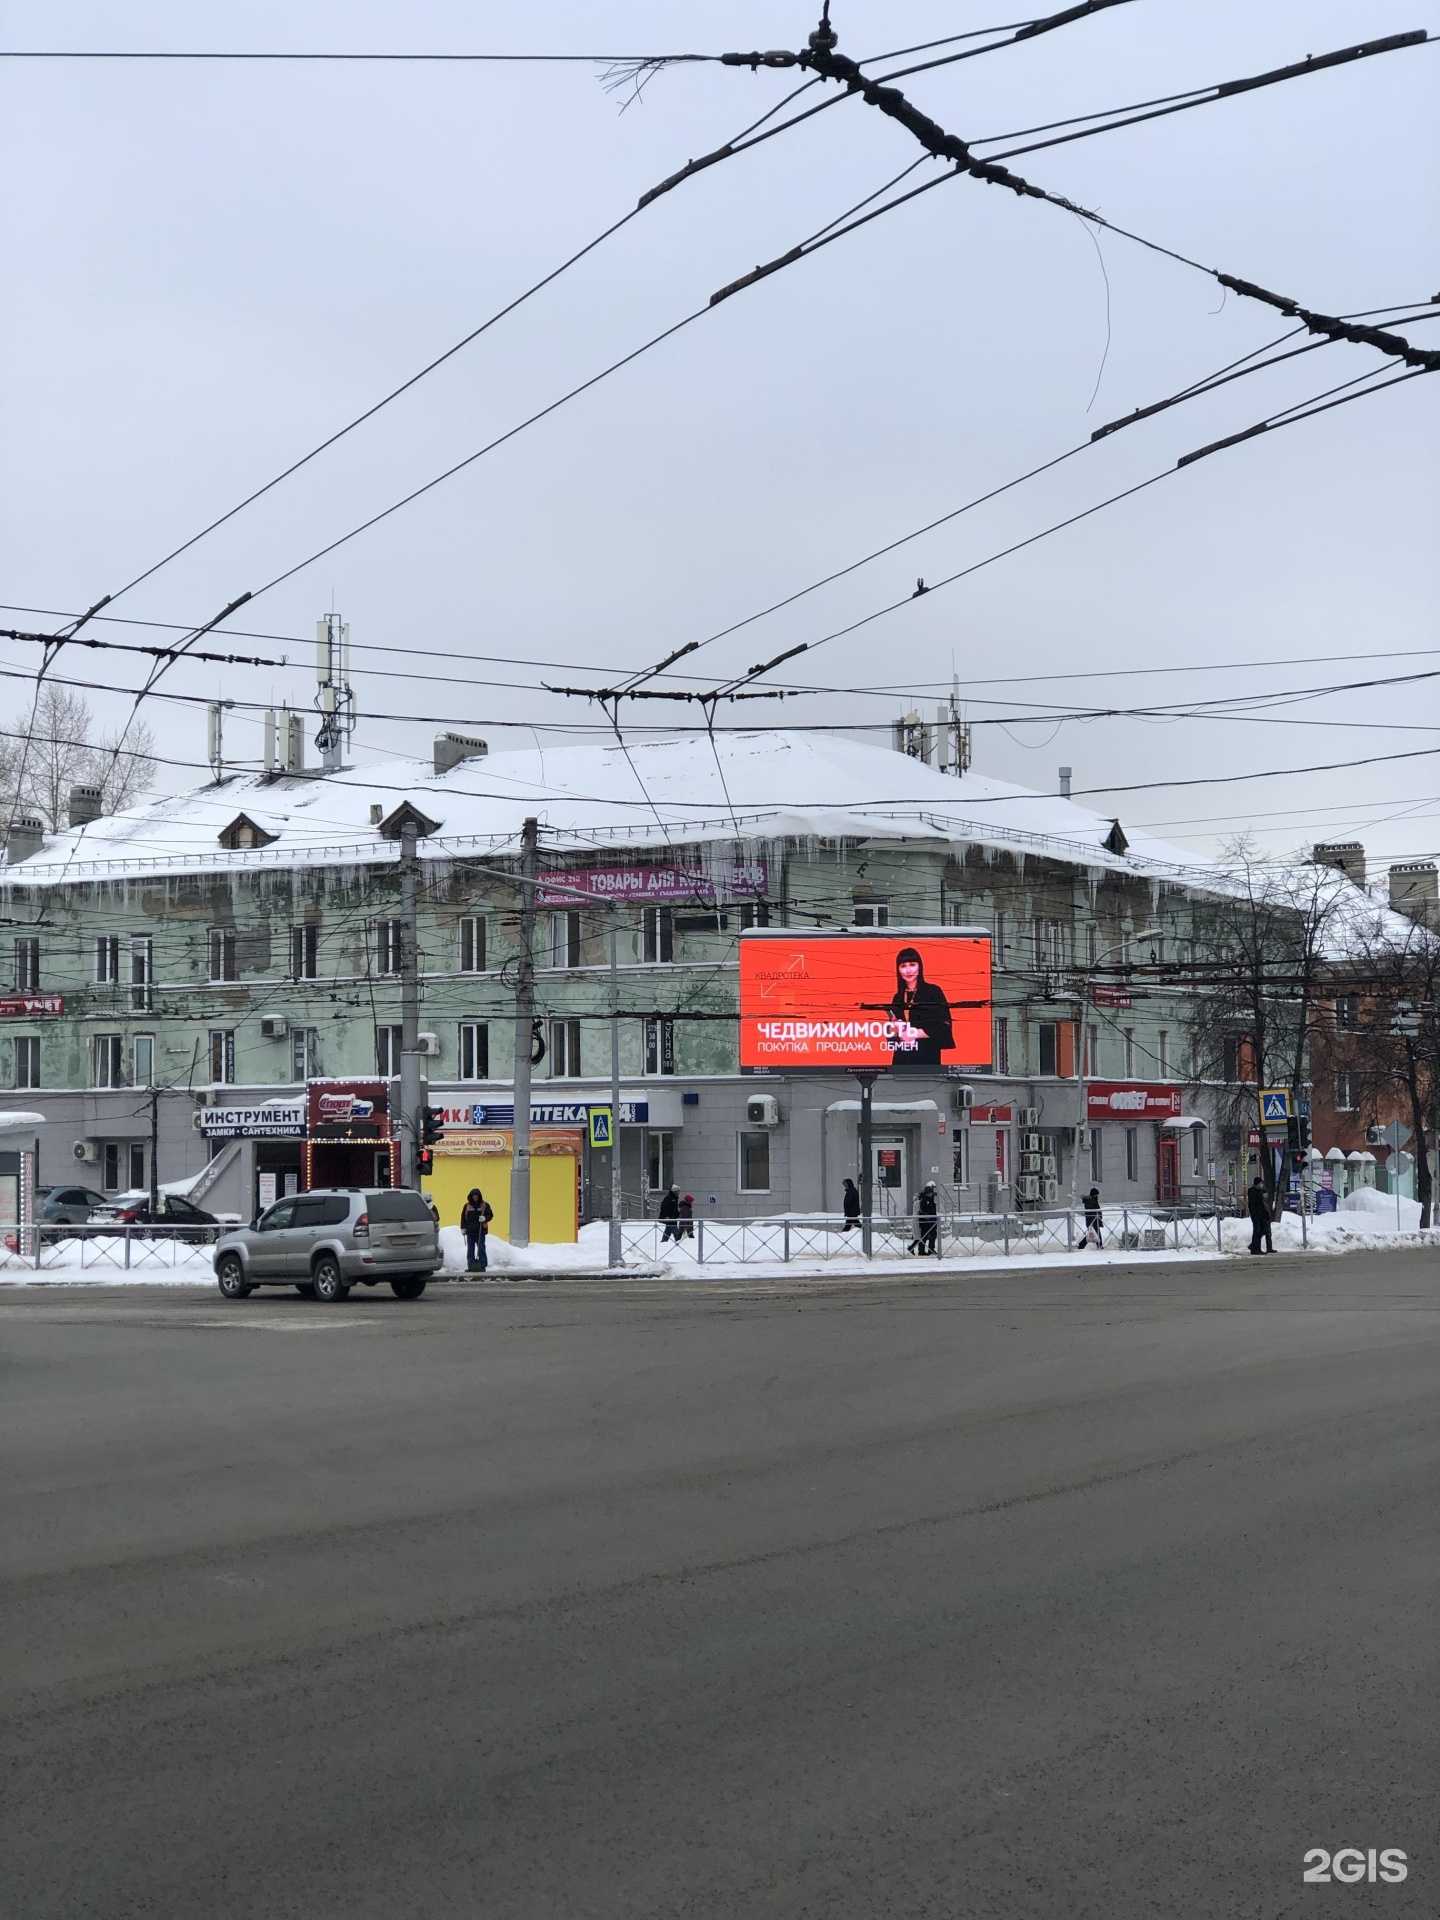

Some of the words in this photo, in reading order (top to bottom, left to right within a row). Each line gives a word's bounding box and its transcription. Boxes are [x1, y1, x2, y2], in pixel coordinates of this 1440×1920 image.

[591, 872, 642, 891] ТОВАРЫ
[648, 870, 674, 890] ДЛЯ
[757, 1021, 918, 1041] ЧЕДВИЖИМОСТЬ
[758, 1041, 808, 1052] ПОКУПКА
[816, 1041, 872, 1053] ПРОДАЖА
[880, 1041, 918, 1052] ОБМЕН
[204, 1110, 300, 1125] ИНСТРУМЕНТ
[529, 1106, 587, 1120] ПТЕКА
[206, 1127, 235, 1137] ЗАМКИ
[241, 1126, 301, 1136] САНТЕХНИКА
